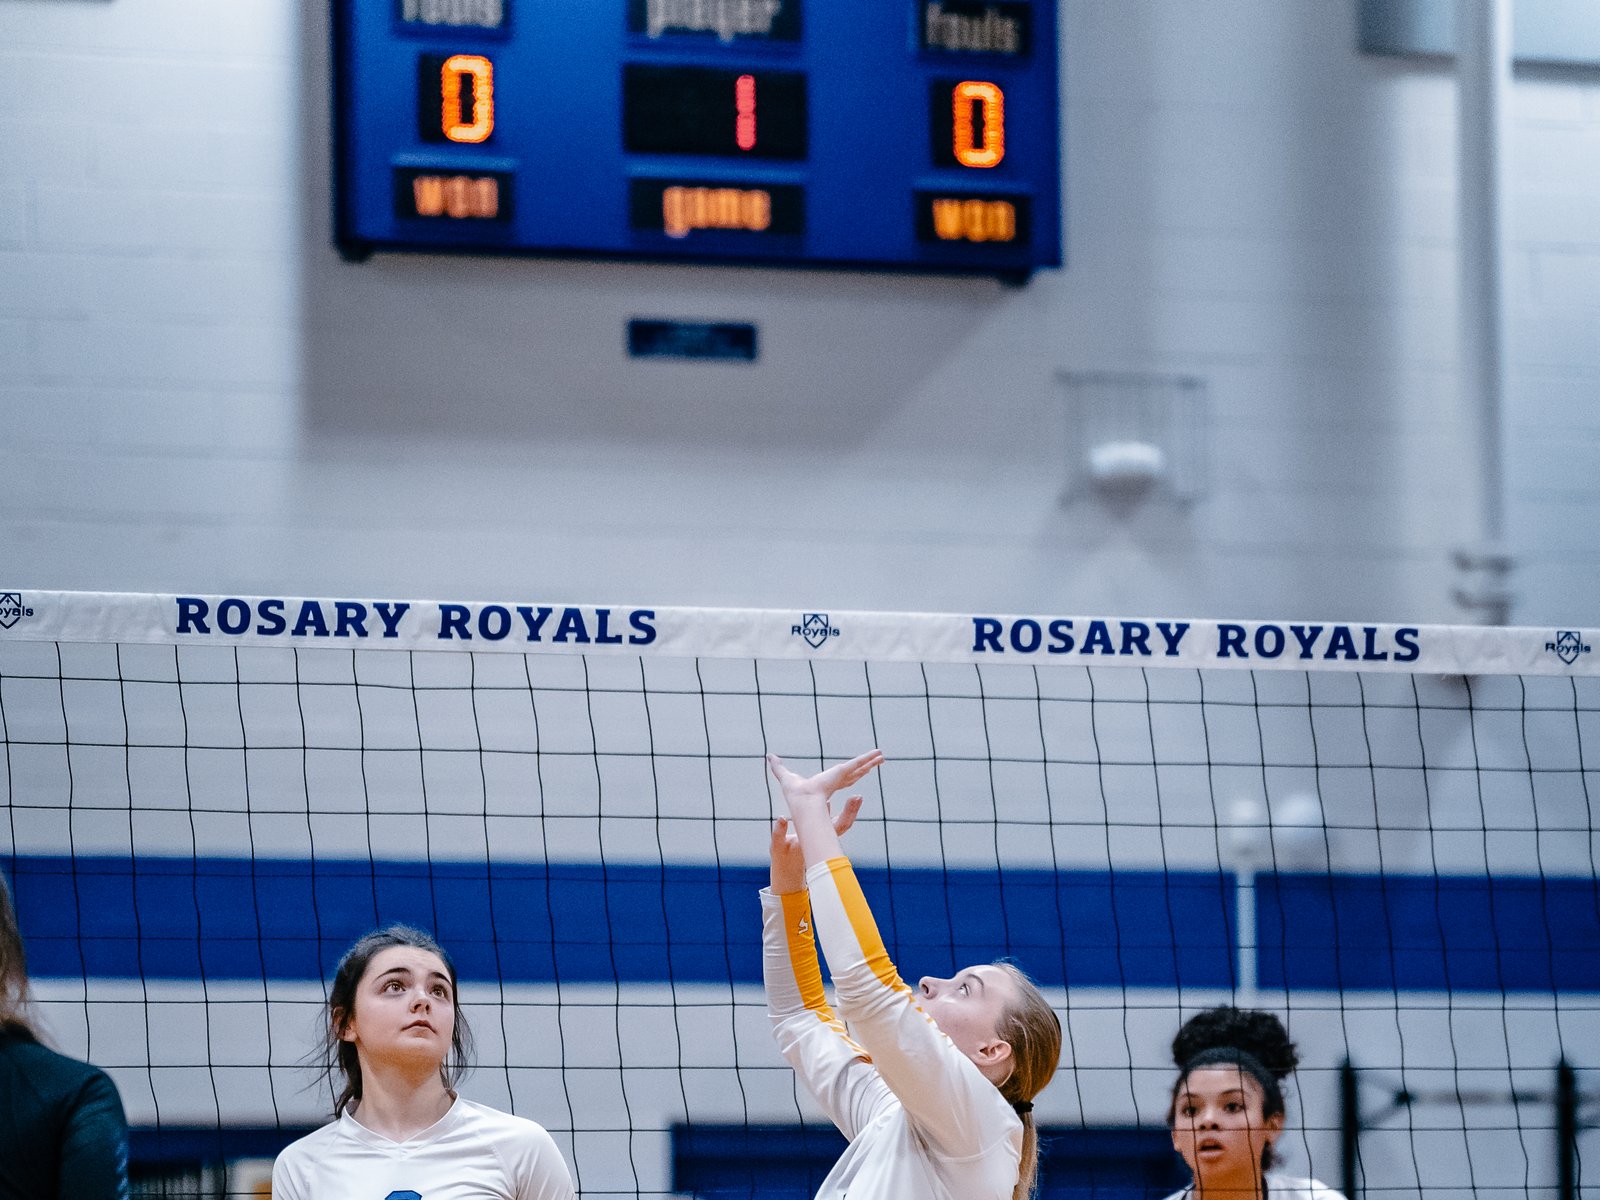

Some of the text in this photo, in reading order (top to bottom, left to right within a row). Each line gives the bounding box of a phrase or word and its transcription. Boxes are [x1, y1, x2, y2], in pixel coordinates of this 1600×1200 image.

[441, 54, 494, 143] 0
[736, 74, 756, 150] 1
[952, 81, 1005, 168] 0
[176, 597, 657, 645] ROSARY ROYALS
[791, 625, 840, 638] Royals
[972, 617, 1420, 661] ROSARY ROYALS
[1545, 642, 1591, 655] Royals
